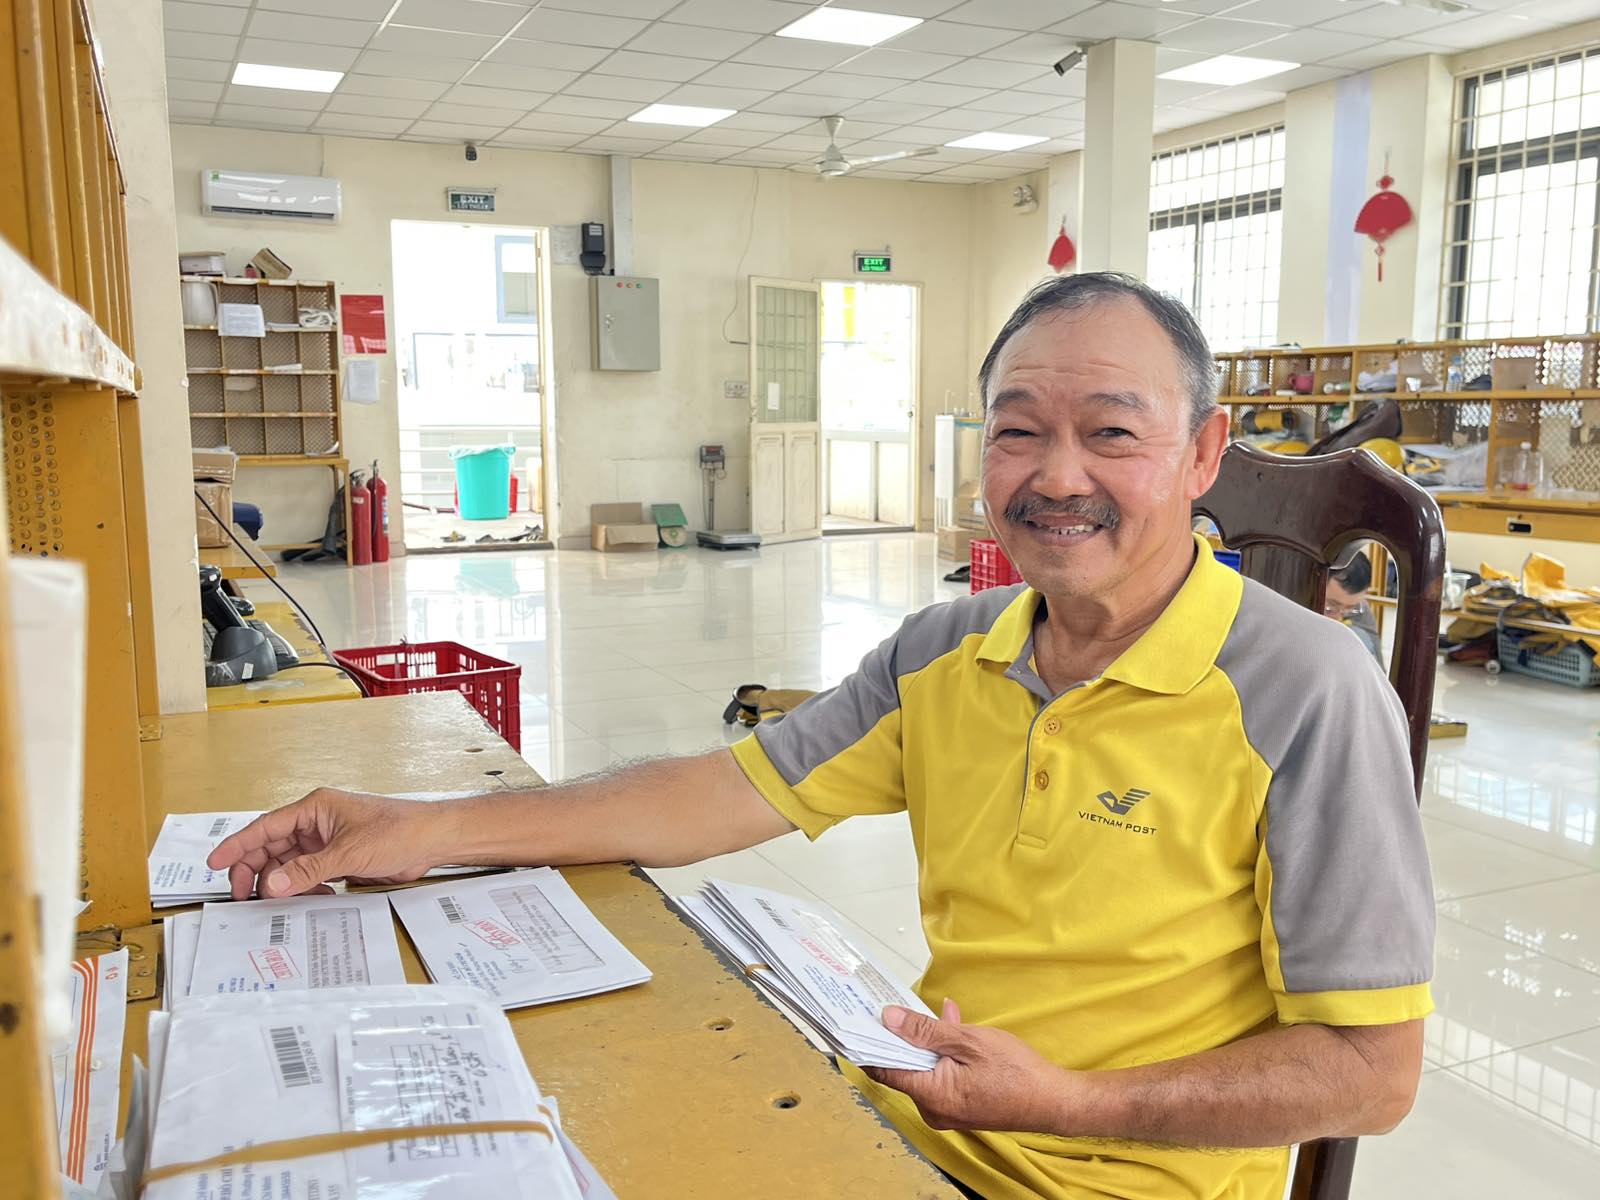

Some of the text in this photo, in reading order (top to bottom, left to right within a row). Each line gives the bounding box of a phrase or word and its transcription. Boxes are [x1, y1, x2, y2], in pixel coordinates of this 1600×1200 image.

[459, 195, 485, 204] EXIT
[1078, 810, 1158, 836] VIETNAM POST
